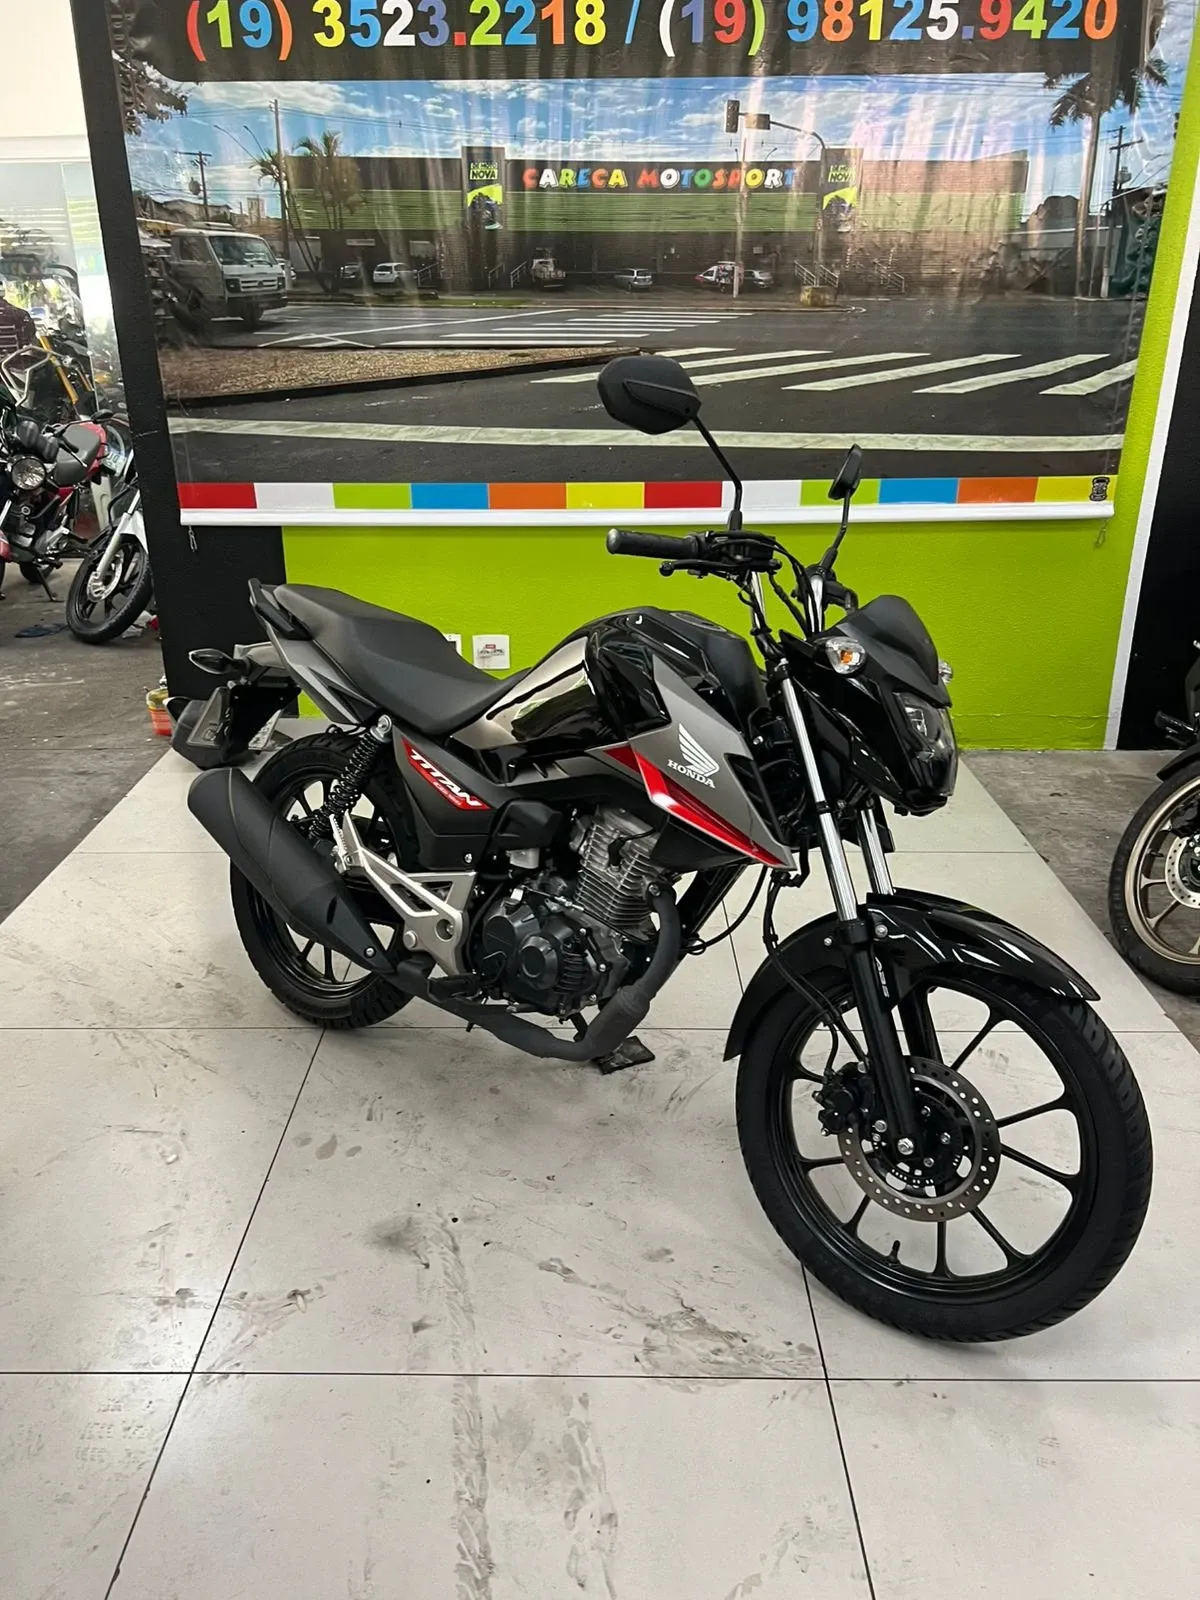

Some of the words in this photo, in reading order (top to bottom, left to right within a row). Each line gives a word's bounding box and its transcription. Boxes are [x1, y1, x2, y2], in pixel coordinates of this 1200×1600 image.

[186, 0, 292, 62] (19)
[313, 0, 607, 48] 3523.2218
[658, 0, 767, 57] (19)
[787, 0, 1118, 42] 98125.9420
[522, 168, 628, 189] CARECA
[636, 168, 797, 189] MOTOSPORT
[410, 748, 483, 807] TITAN
[667, 759, 716, 789] HONDA
